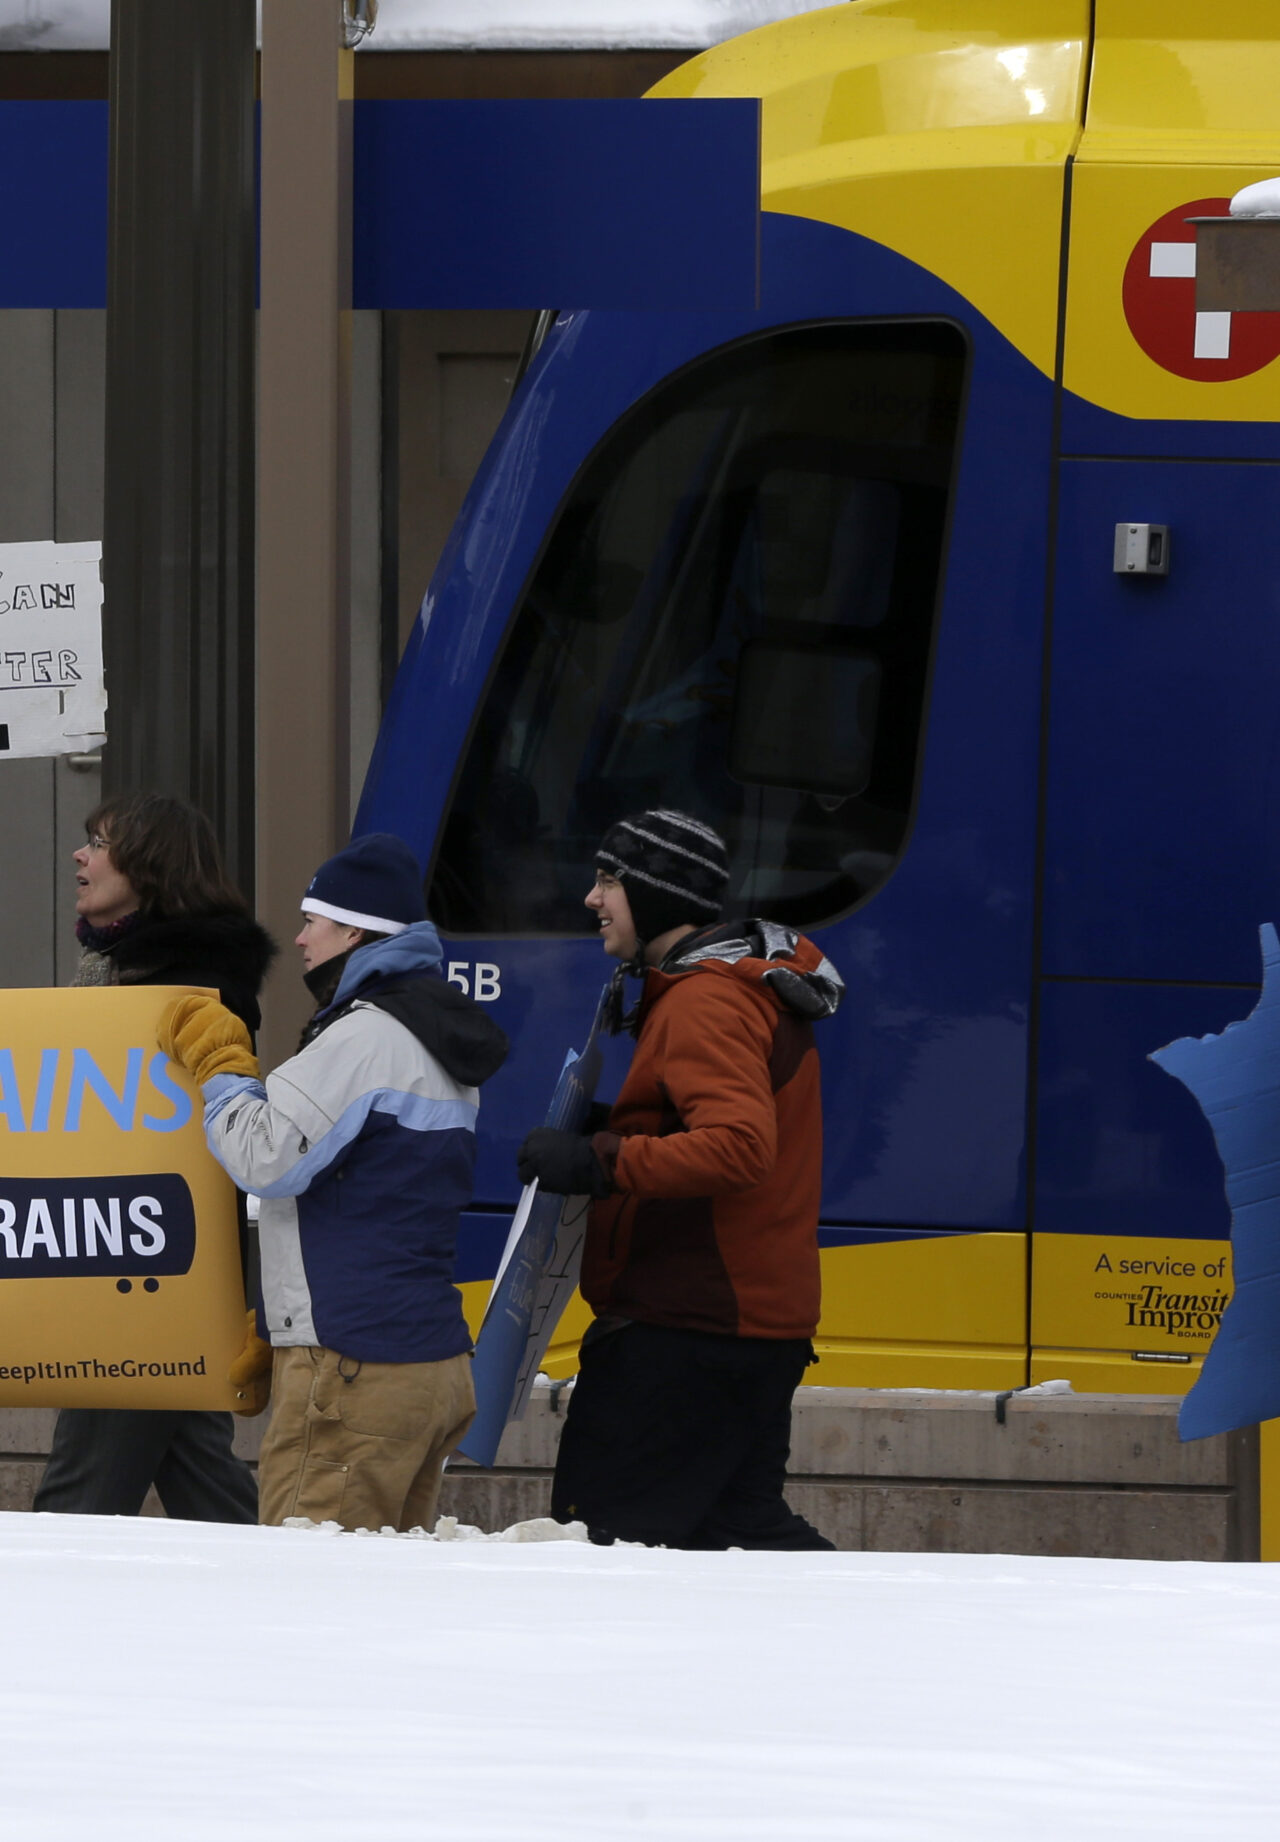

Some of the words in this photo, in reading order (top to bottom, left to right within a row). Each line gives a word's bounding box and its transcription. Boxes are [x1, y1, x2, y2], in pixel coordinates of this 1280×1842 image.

[447, 961, 502, 1002] 5B
[1094, 1253, 1113, 1273] A
[1119, 1256, 1196, 1277] service
[1203, 1257, 1226, 1278] of
[1094, 1291, 1143, 1301] COUNTIES
[1140, 1285, 1230, 1313] Transit
[1177, 1331, 1211, 1339] BOARD
